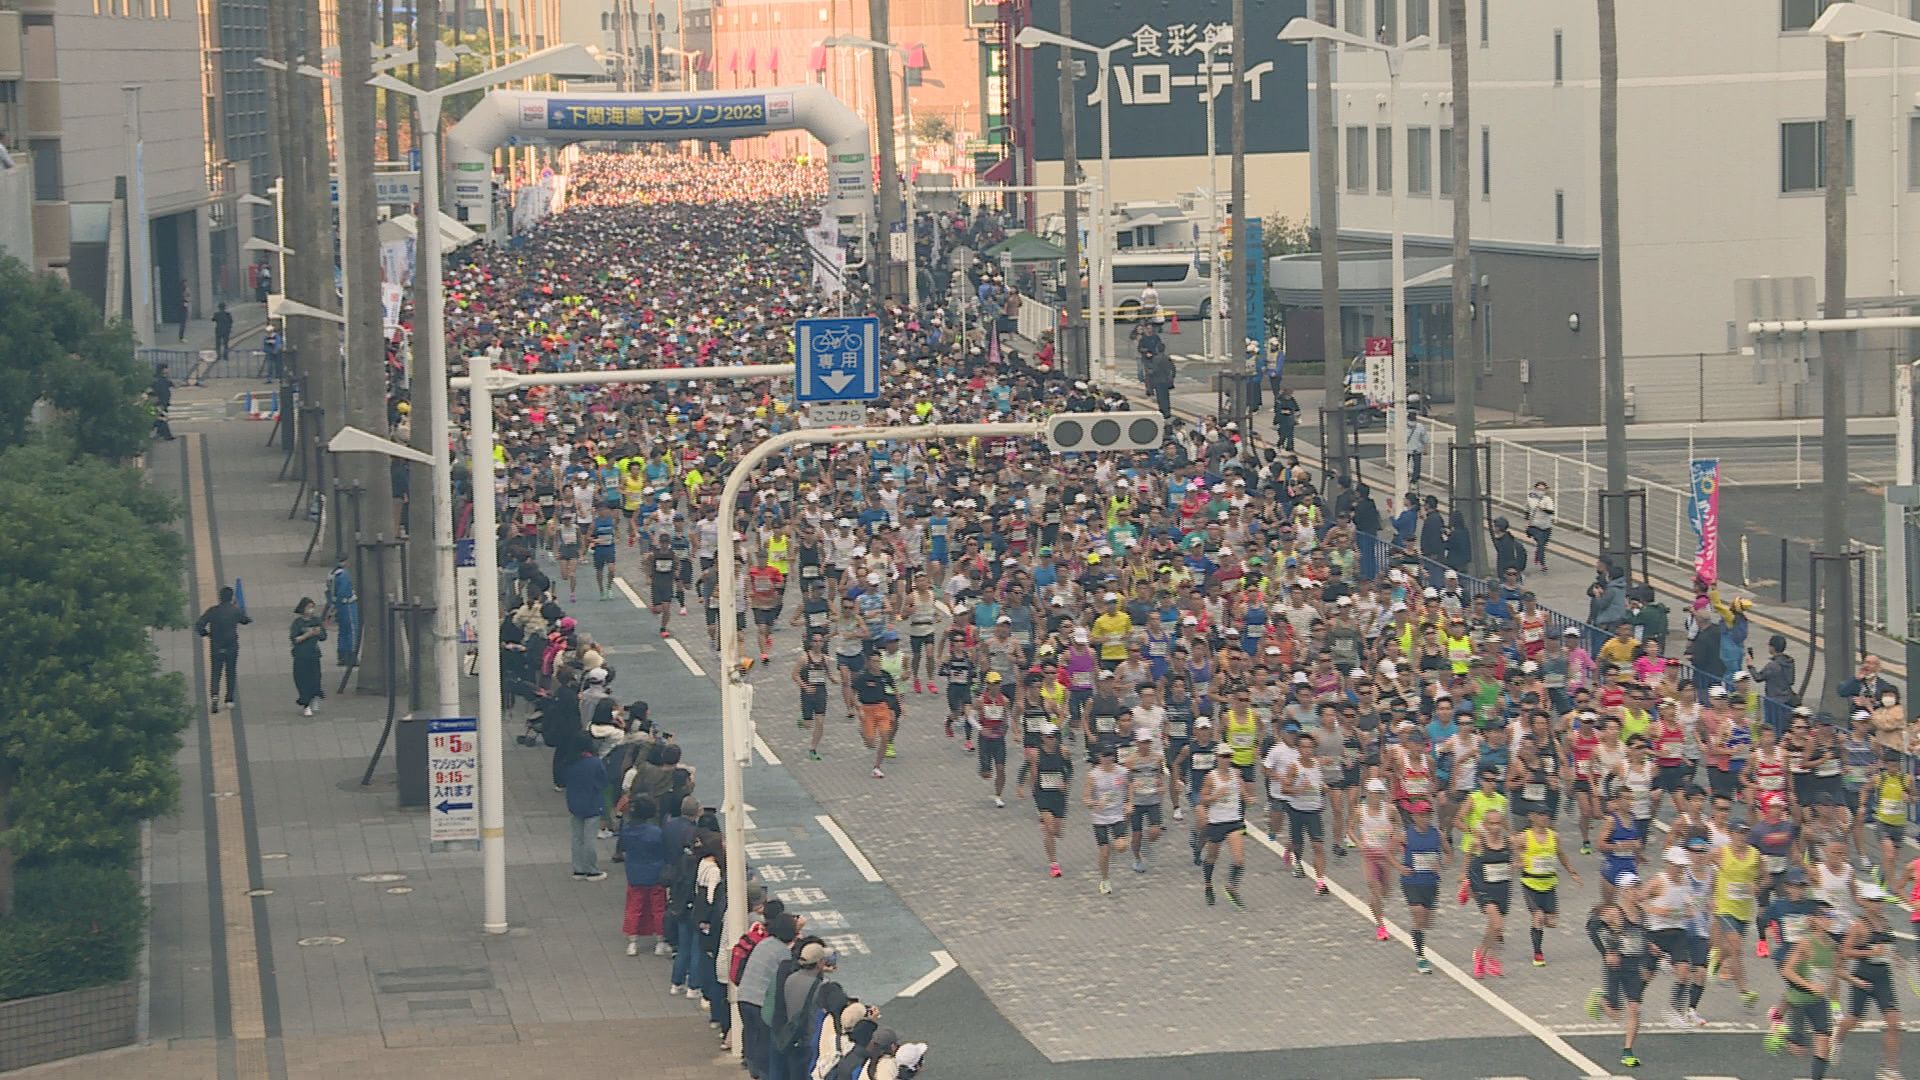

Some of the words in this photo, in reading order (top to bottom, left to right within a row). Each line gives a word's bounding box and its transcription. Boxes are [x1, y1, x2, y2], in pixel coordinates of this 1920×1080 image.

[814, 410, 861, 422] ここから
[431, 758, 474, 770] マンションへは
[434, 785, 473, 798] 入れます
